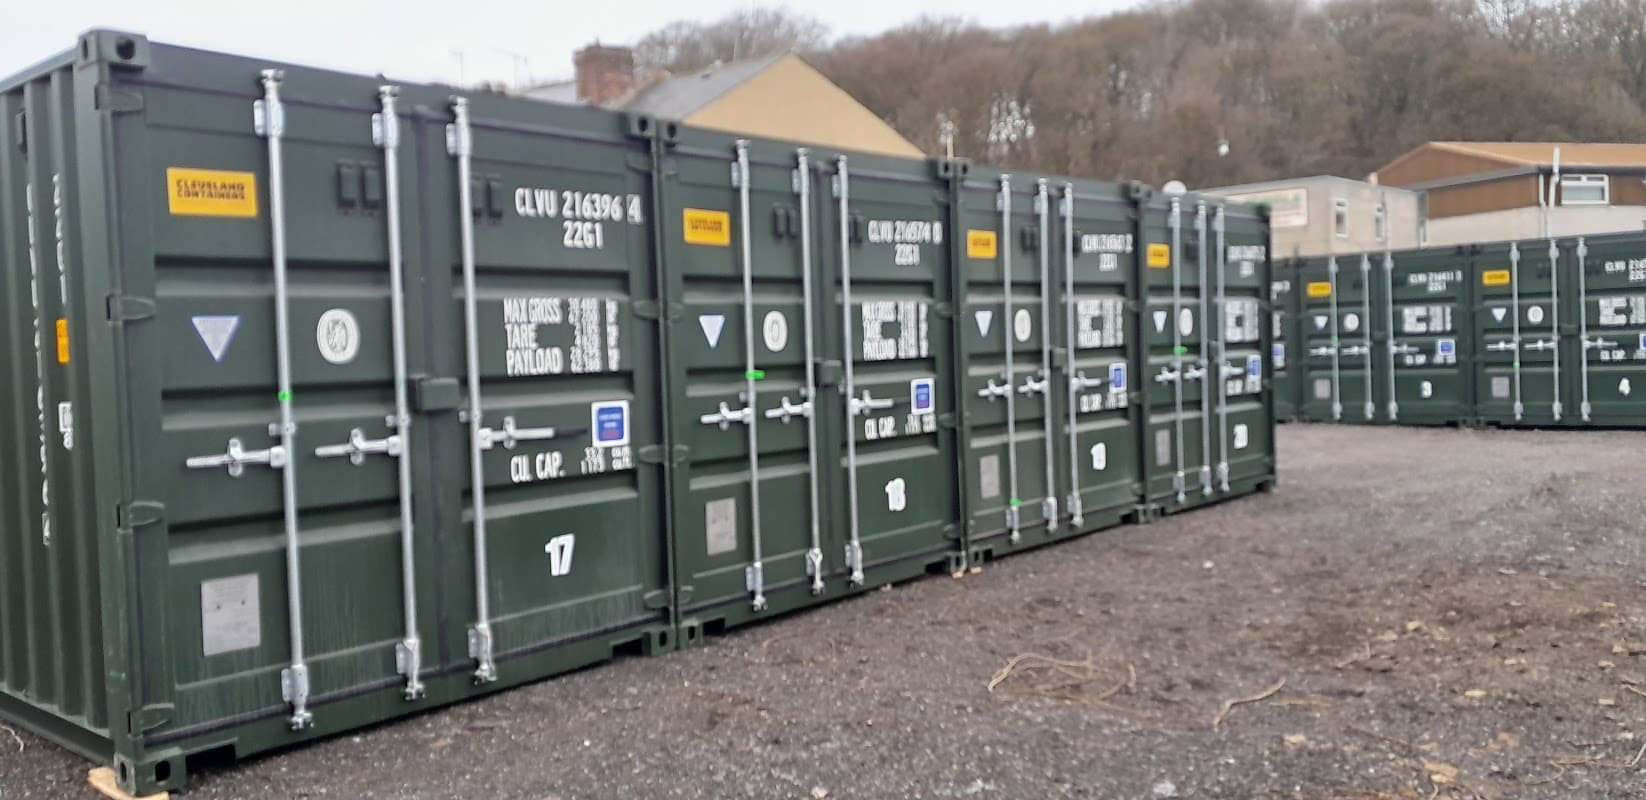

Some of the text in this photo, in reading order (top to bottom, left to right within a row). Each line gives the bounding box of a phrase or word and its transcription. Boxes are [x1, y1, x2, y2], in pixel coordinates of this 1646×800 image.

[176, 179, 245, 191] CLEVELAND
[177, 189, 246, 200] CONTAINERS
[515, 187, 643, 225] CLVU 216396 4
[562, 219, 604, 250] 22G1
[503, 297, 563, 324] MAX GROSS
[504, 322, 539, 350] TARE
[506, 346, 564, 377] PAYLOAD
[1618, 378, 1631, 396] 4
[510, 454, 533, 483] CU.
[535, 451, 567, 480] CAP.
[884, 477, 906, 512] 18
[544, 533, 575, 577] 17
